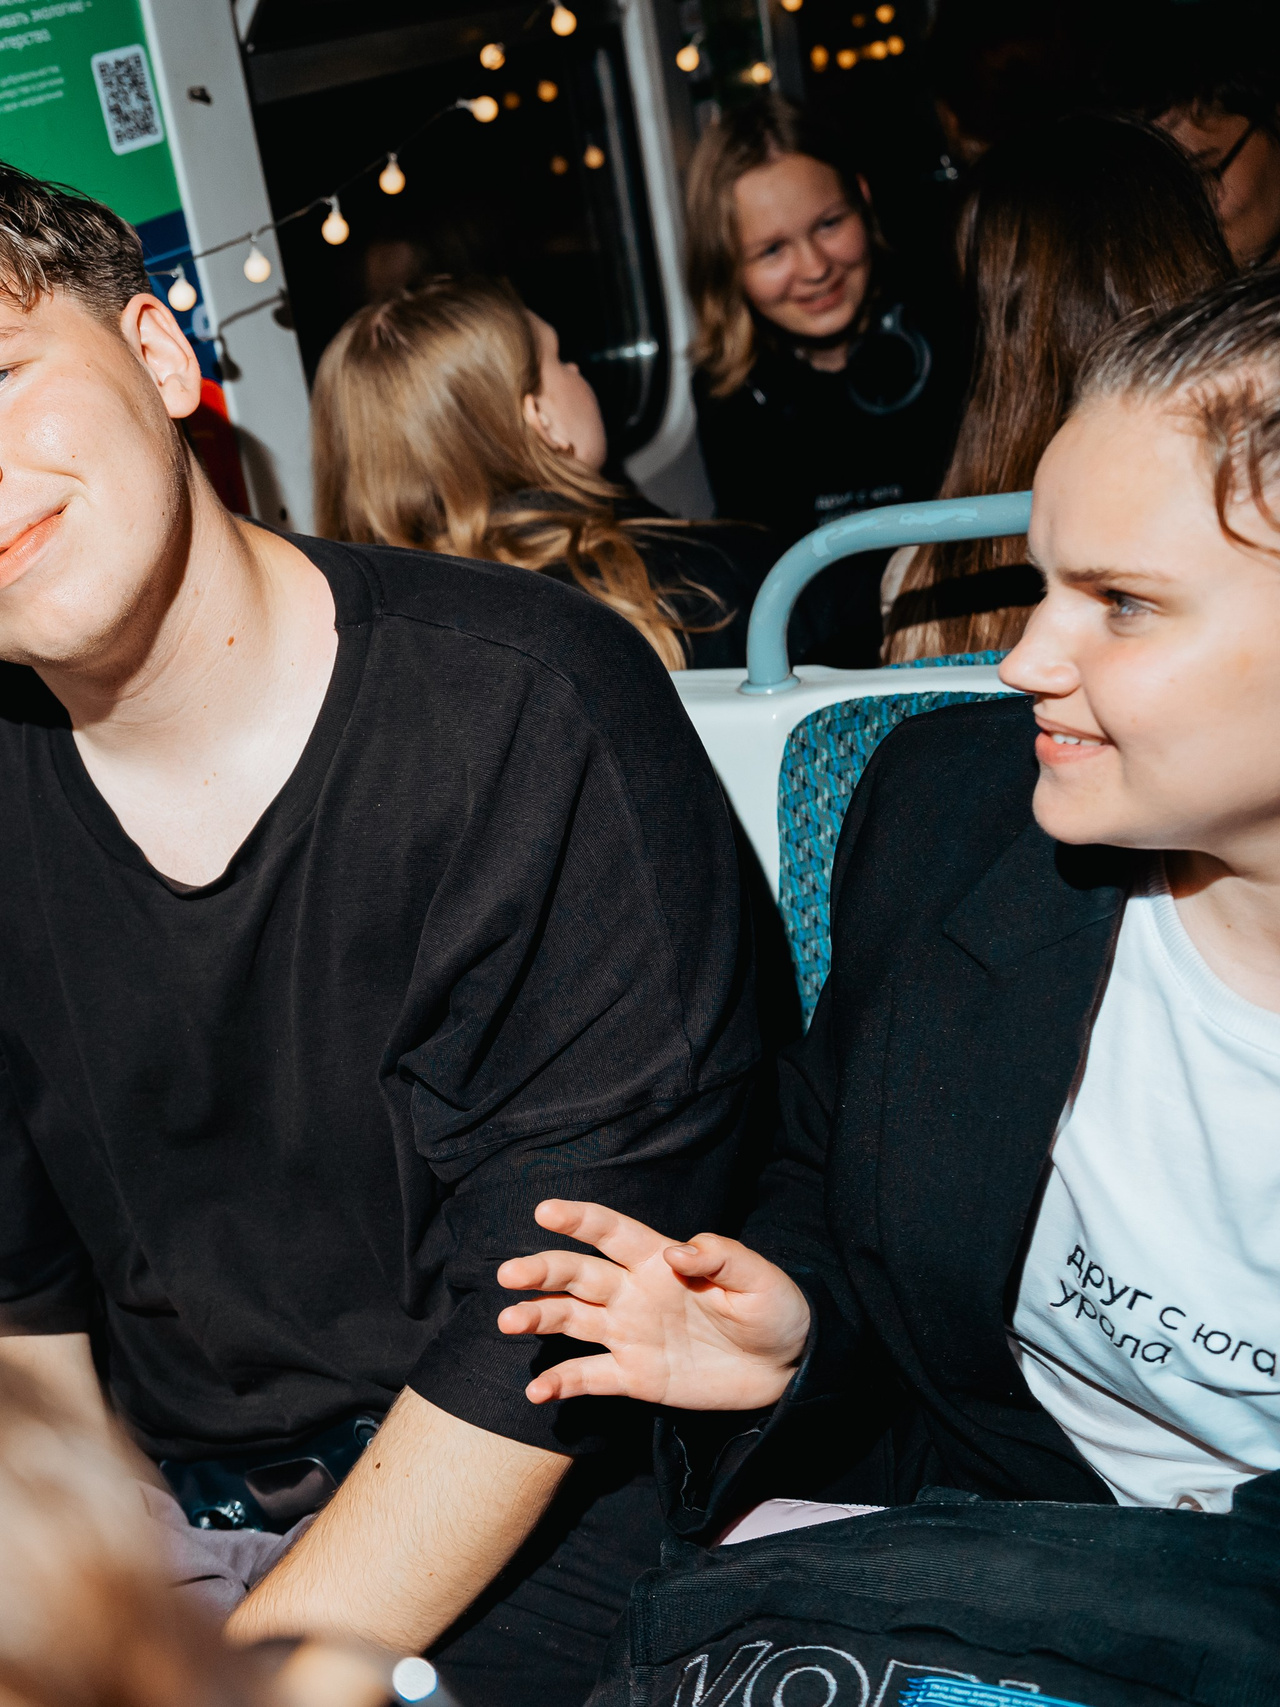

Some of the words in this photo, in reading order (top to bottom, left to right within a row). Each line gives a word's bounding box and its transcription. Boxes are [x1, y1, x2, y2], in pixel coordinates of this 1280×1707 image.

[1049, 1279, 1174, 1365] урала
[1066, 1244, 1153, 1311] друг
[1159, 1306, 1187, 1331] с
[1192, 1323, 1278, 1377] юга
